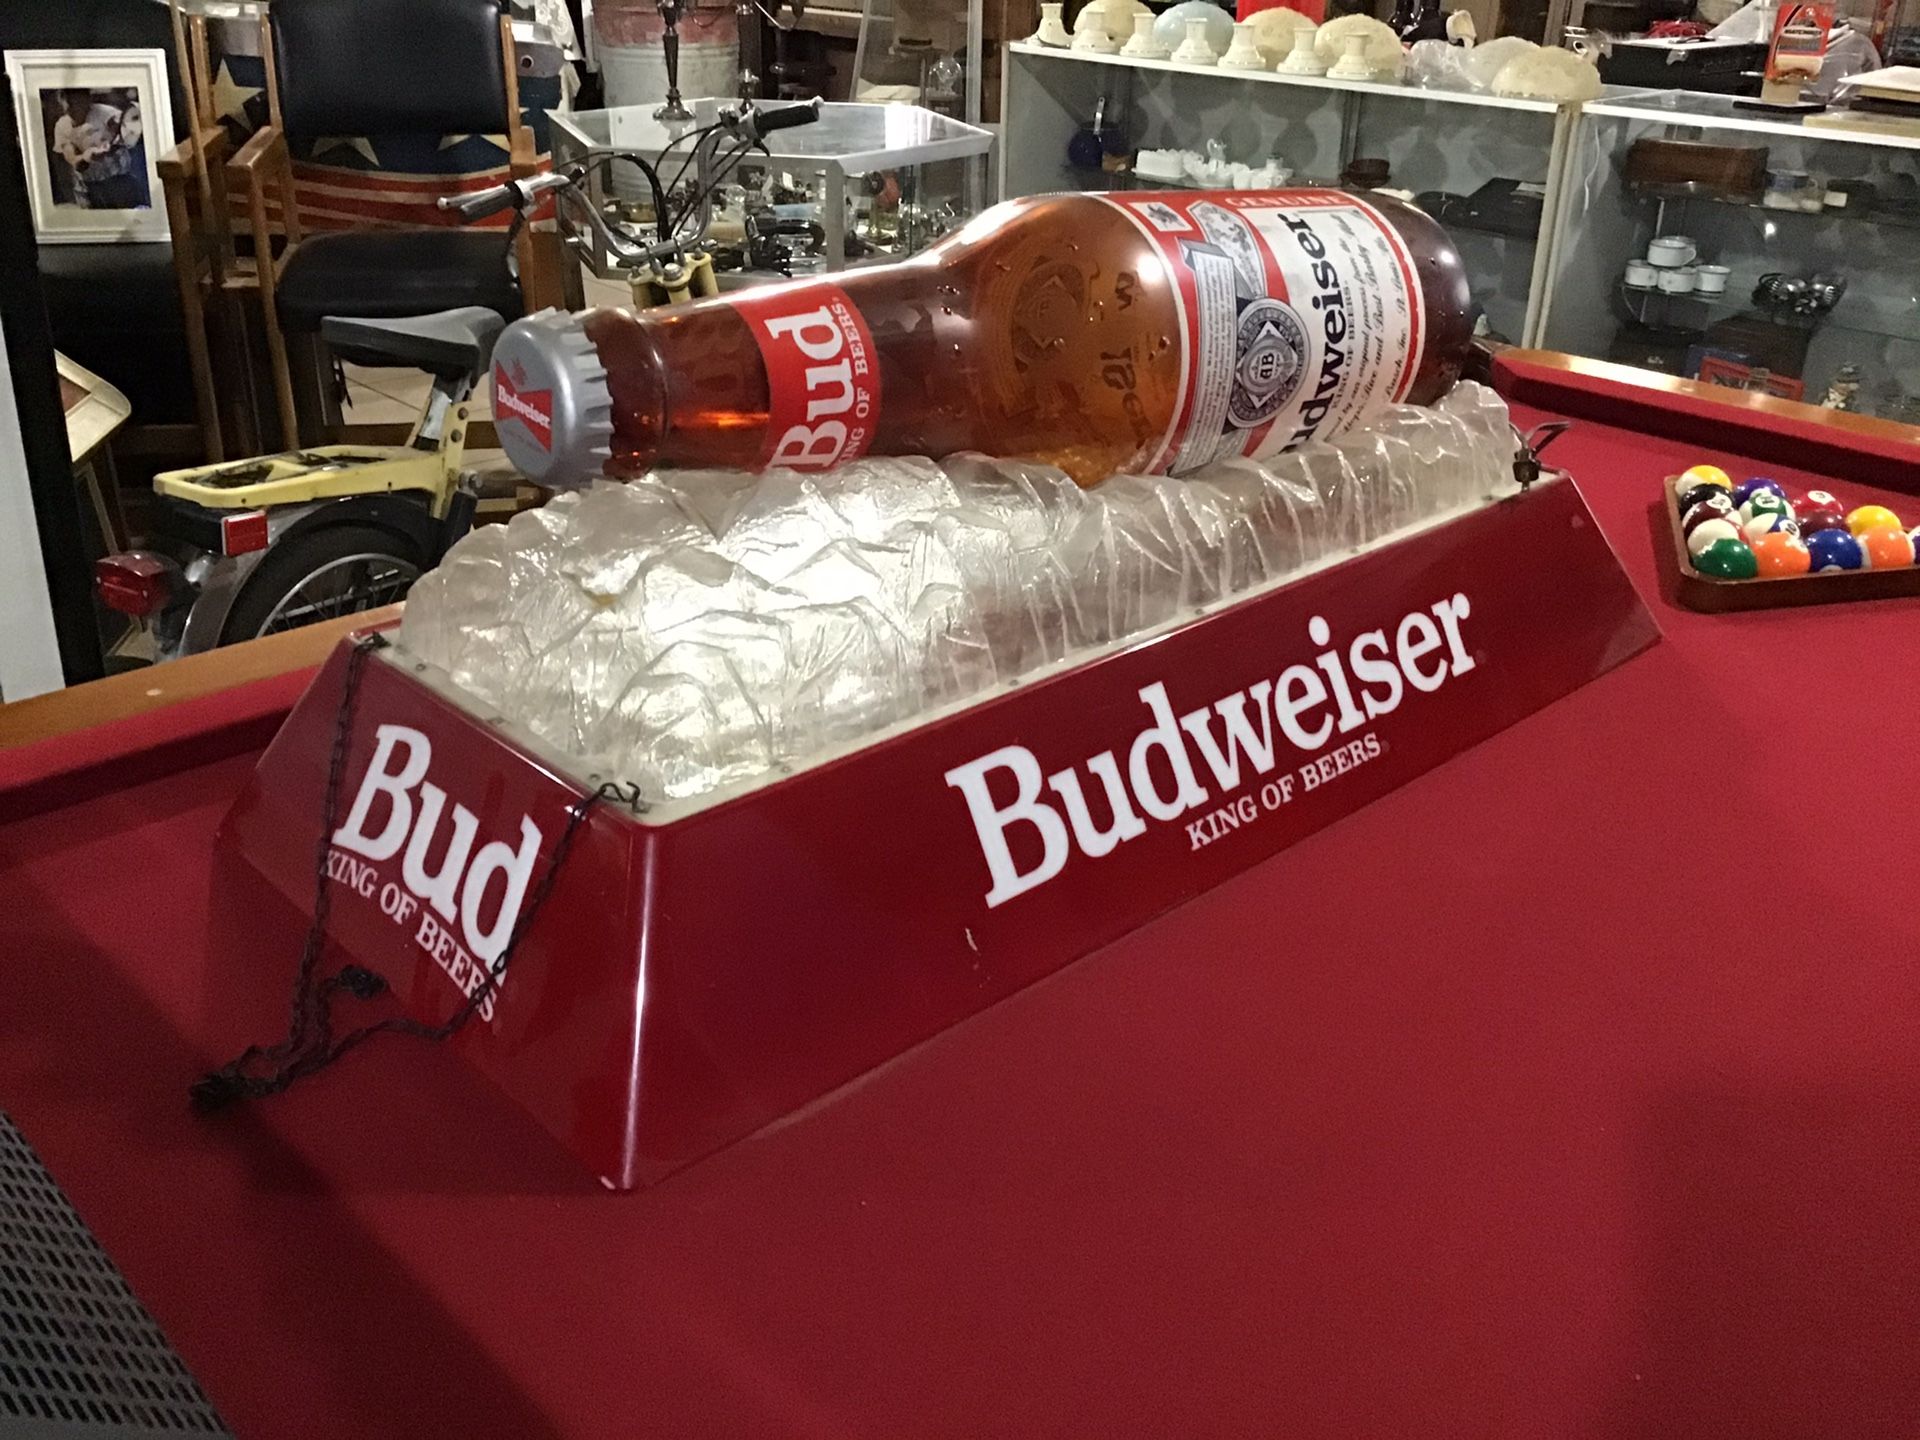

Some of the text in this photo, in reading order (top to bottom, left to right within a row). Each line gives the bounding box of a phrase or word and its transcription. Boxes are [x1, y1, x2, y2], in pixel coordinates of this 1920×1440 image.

[1225, 195, 1350, 207] GENUINE
[1277, 213, 1346, 456] udweiser
[1343, 285, 1355, 341] BEERS
[1344, 345, 1354, 368] OF
[497, 383, 551, 430] Budweiser
[764, 305, 855, 470] Bud
[832, 302, 871, 465] ING OF BEERS
[1332, 371, 1349, 409] KING
[944, 592, 1477, 909] Budweiser
[1185, 733, 1382, 851] KING OF BEERS
[320, 849, 379, 898] KING
[380, 882, 418, 925] OF
[331, 724, 543, 988] Bud
